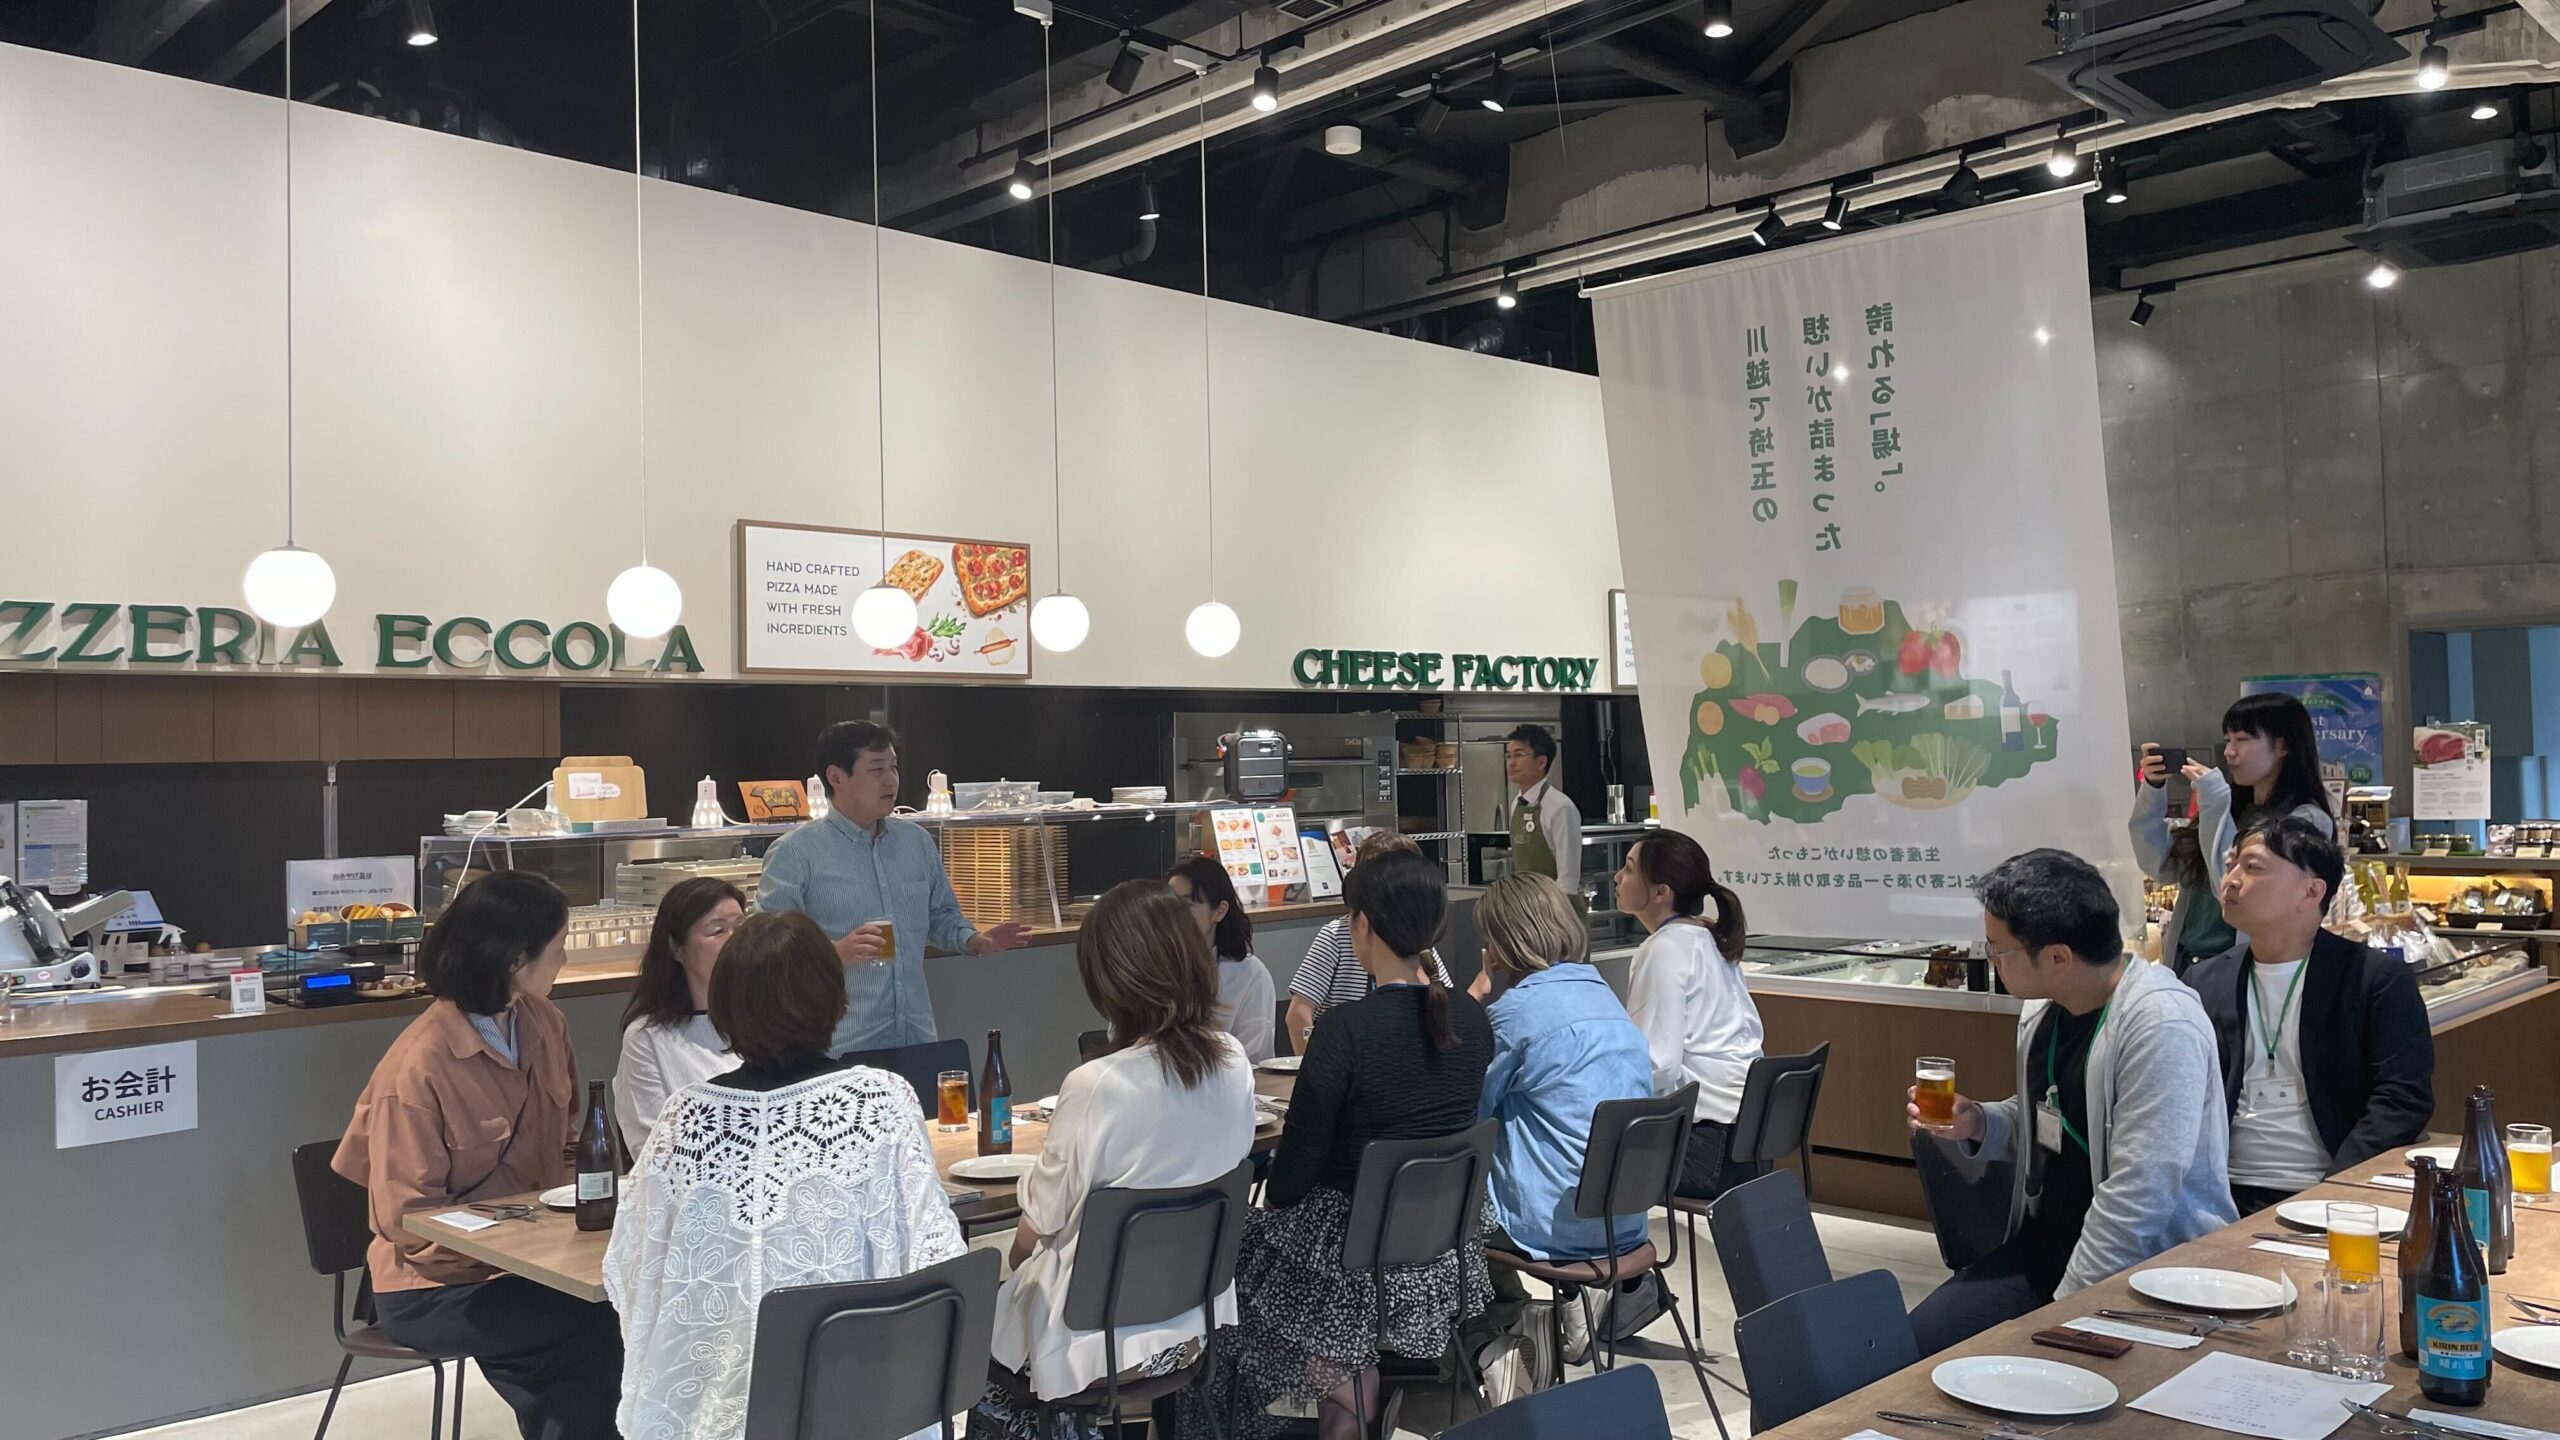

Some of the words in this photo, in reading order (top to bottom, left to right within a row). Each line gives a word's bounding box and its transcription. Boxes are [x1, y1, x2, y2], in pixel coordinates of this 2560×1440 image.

[766, 560, 802, 574] HAND
[806, 563, 860, 577] CRAFTED
[767, 581, 800, 594] PIZZA
[804, 583, 838, 596] MADE
[767, 602, 798, 614] WITH
[802, 604, 842, 616] FRESH
[767, 623, 847, 636] INGREDIENTS
[374, 613, 704, 672] ECCOLA
[1293, 648, 1443, 688] CHEESE
[1453, 653, 1599, 689] FACTORY
[81, 1065, 176, 1103] お会計
[94, 1100, 164, 1121] CASHIER
